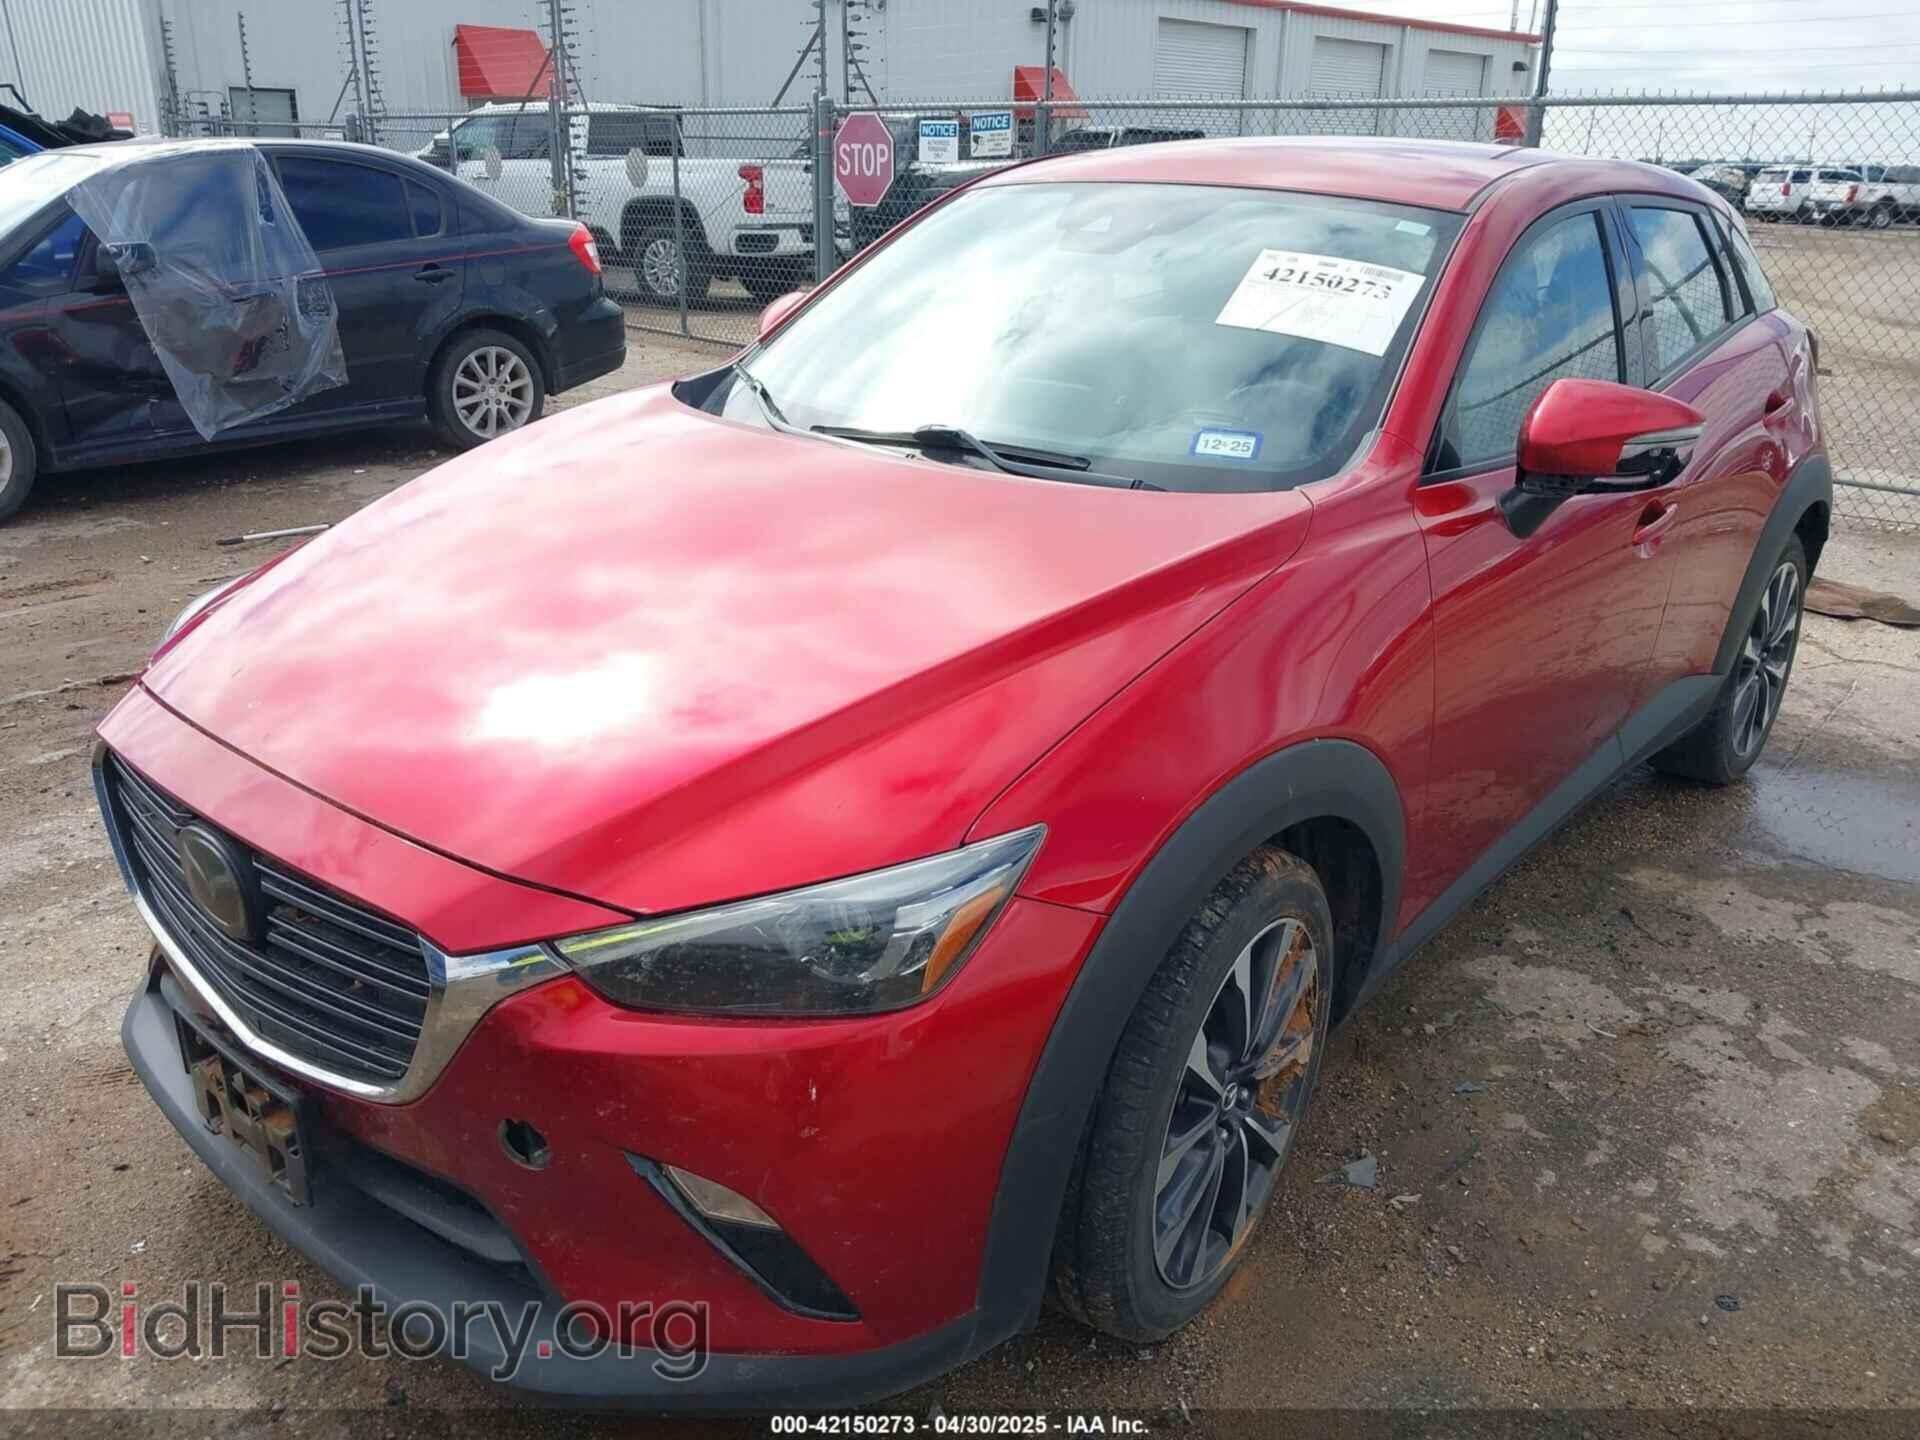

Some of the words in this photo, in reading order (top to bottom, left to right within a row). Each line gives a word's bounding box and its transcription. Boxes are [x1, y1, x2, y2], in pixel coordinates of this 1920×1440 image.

[922, 124, 955, 136] NOTICE
[973, 115, 1009, 129] NOTICE
[839, 143, 888, 177] STOP
[1263, 266, 1392, 300] 42150273
